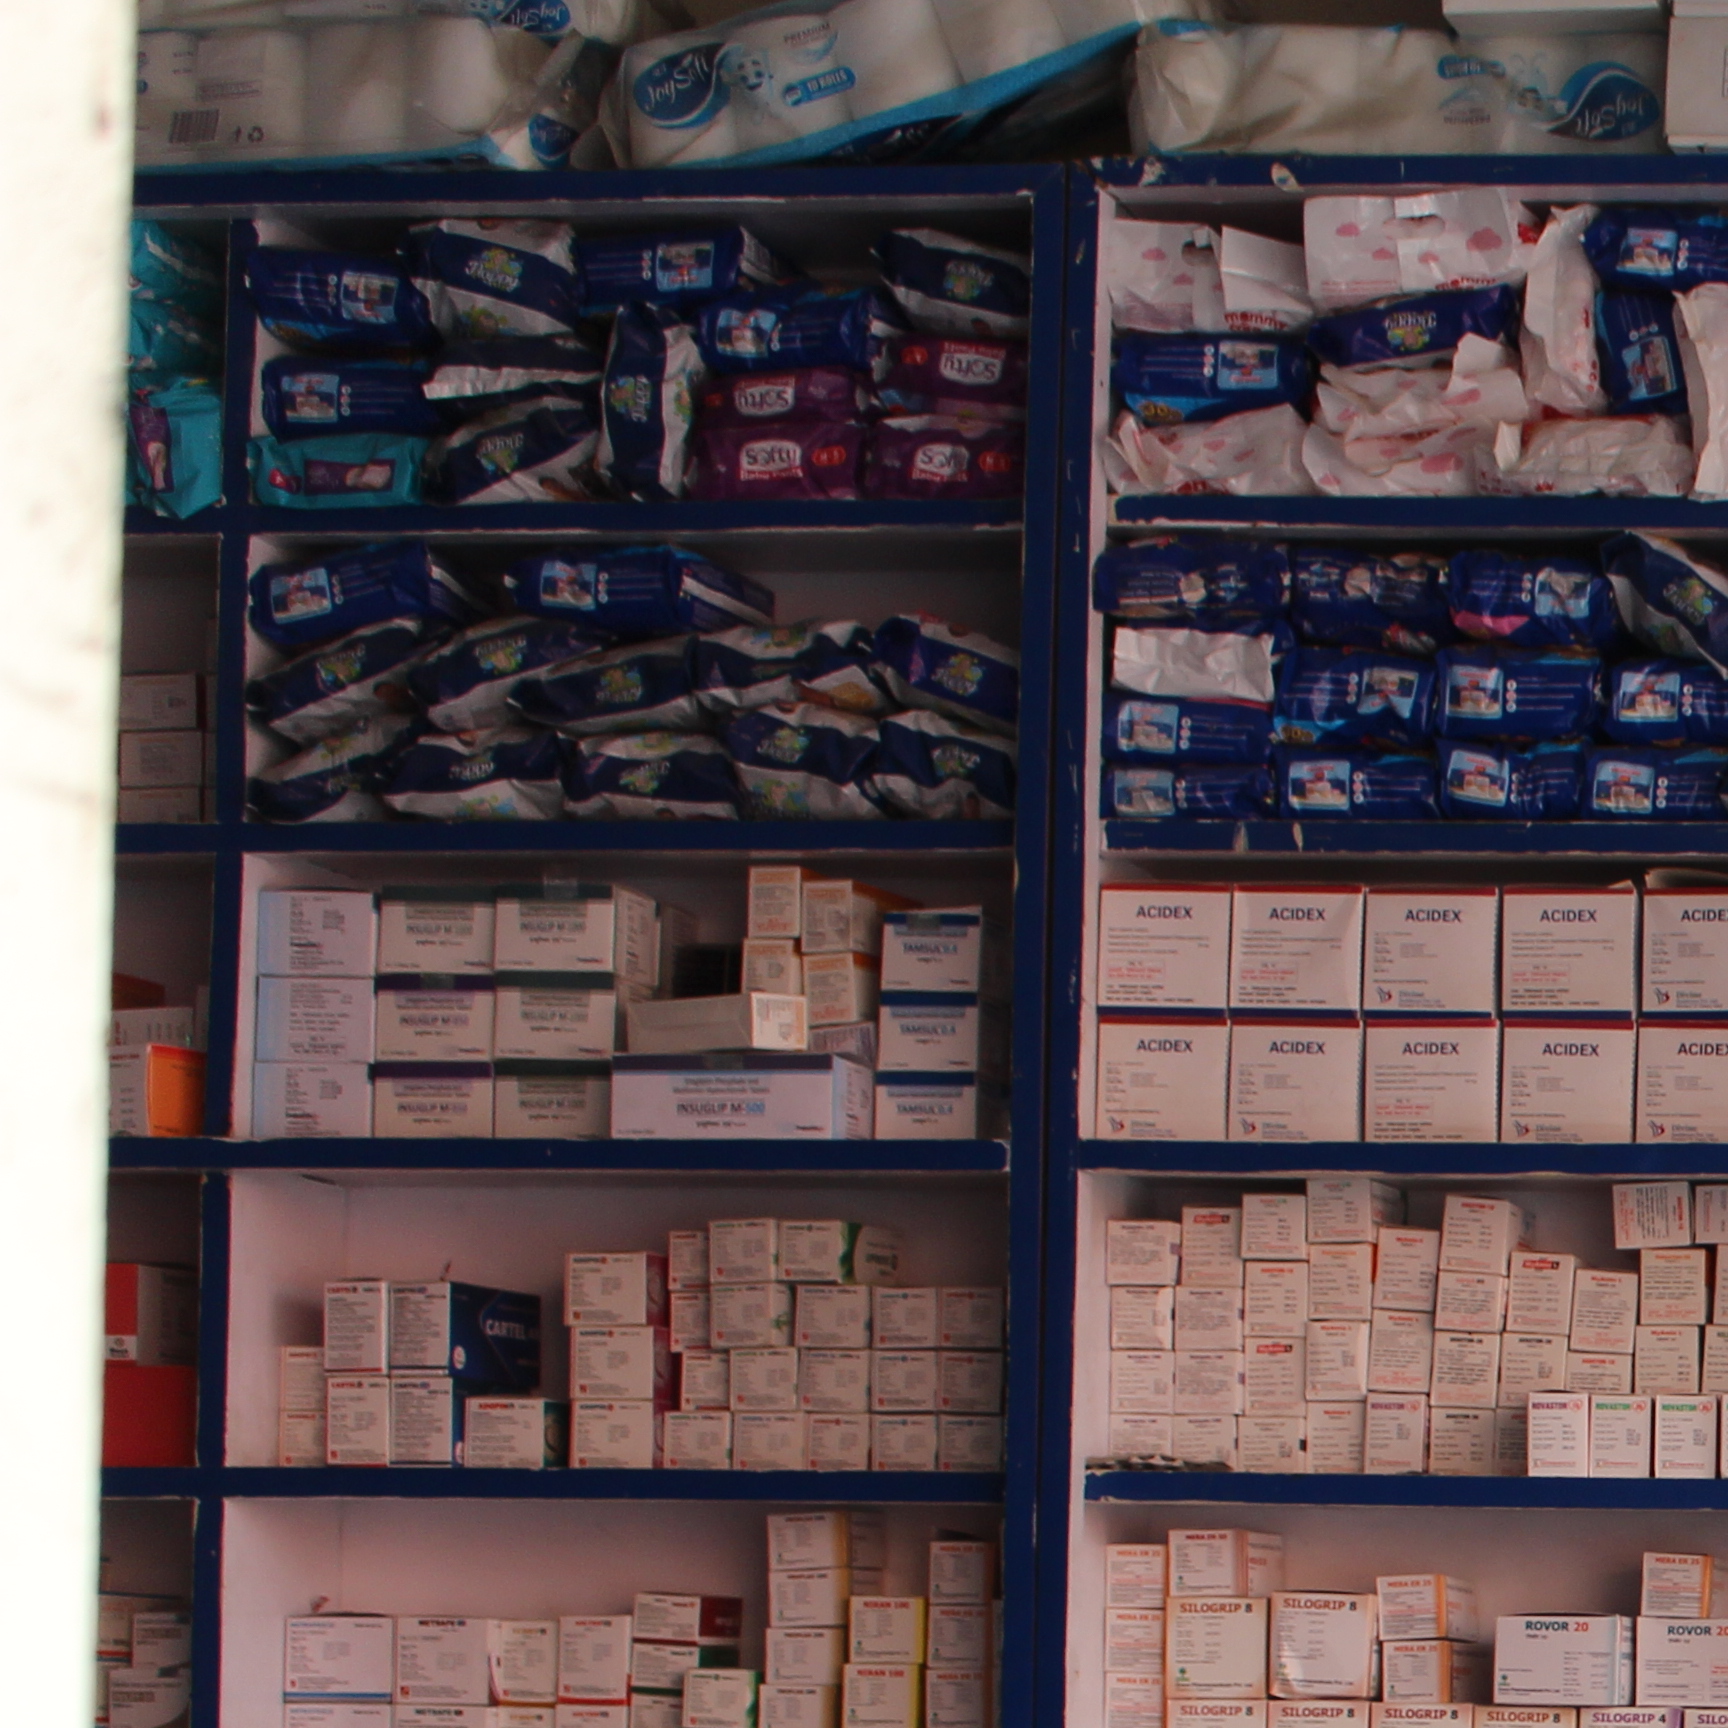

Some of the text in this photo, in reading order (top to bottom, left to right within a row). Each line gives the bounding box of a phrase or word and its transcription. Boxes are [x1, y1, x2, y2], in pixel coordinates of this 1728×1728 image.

[1136, 904, 1193, 921] ACIDEX
[1402, 1041, 1459, 1057] ACIDEX
[1180, 1602, 1240, 1614] SILOGRIP
[1524, 1619, 1590, 1632] ROVOR 20
[1592, 1712, 1653, 1724] SILOGRIP
